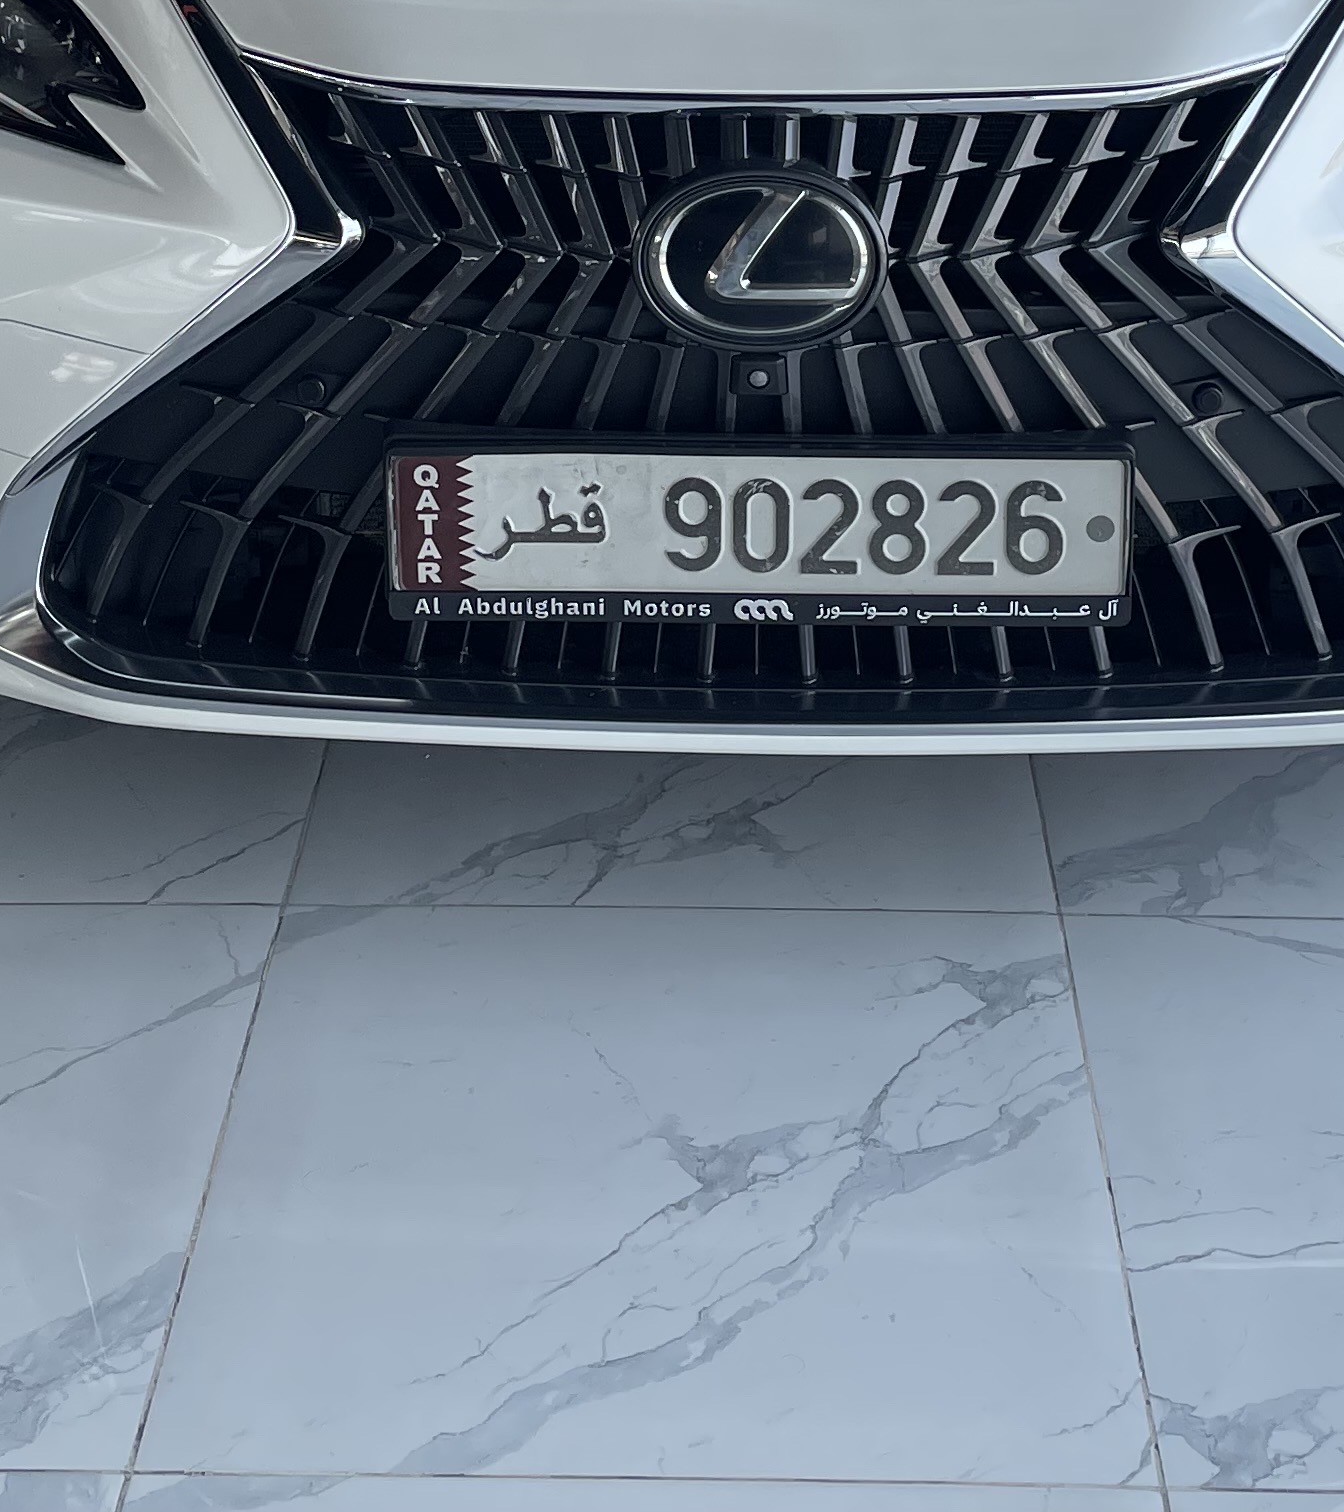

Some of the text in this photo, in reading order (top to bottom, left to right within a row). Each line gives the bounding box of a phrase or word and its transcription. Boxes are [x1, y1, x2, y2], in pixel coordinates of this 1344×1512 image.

[413, 464, 443, 584] QATAR
[473, 482, 608, 561] قطر
[664, 476, 1066, 576] 902826
[414, 597, 712, 619] Al Abdulghani Motors
[815, 601, 909, 620] موتورز
[1098, 598, 1119, 621] آل
